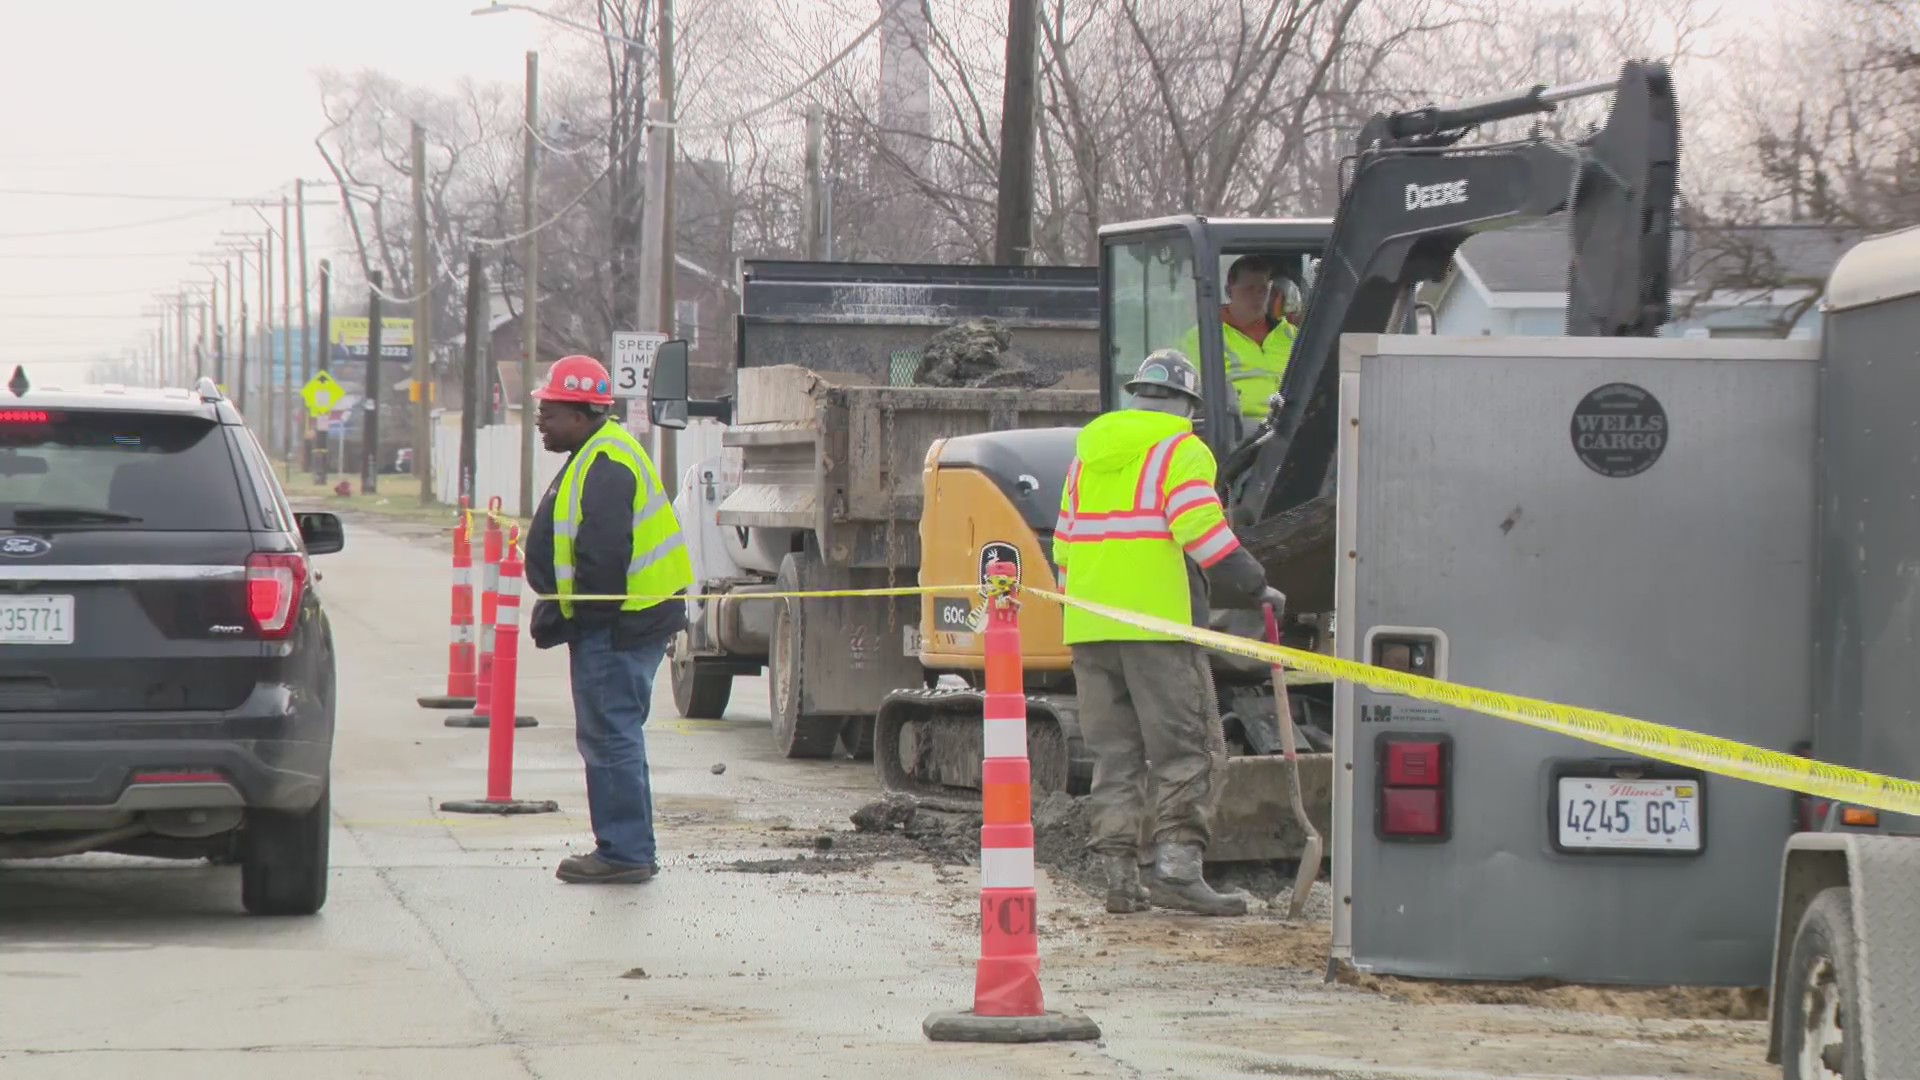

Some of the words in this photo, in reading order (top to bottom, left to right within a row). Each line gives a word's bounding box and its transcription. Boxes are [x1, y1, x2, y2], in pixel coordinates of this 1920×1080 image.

[1404, 179, 1469, 211] DEERE
[619, 340, 660, 351] SPEE
[622, 354, 653, 364] LIMI
[1577, 415, 1663, 432] WELLS
[1578, 433, 1662, 450] CARGO
[3, 539, 37, 552] Ford
[943, 606, 965, 624] 60G
[209, 625, 244, 633] 4WD
[1609, 783, 1664, 798] Illinois
[1567, 799, 1631, 834] 4245
[1646, 801, 1676, 835] GC
